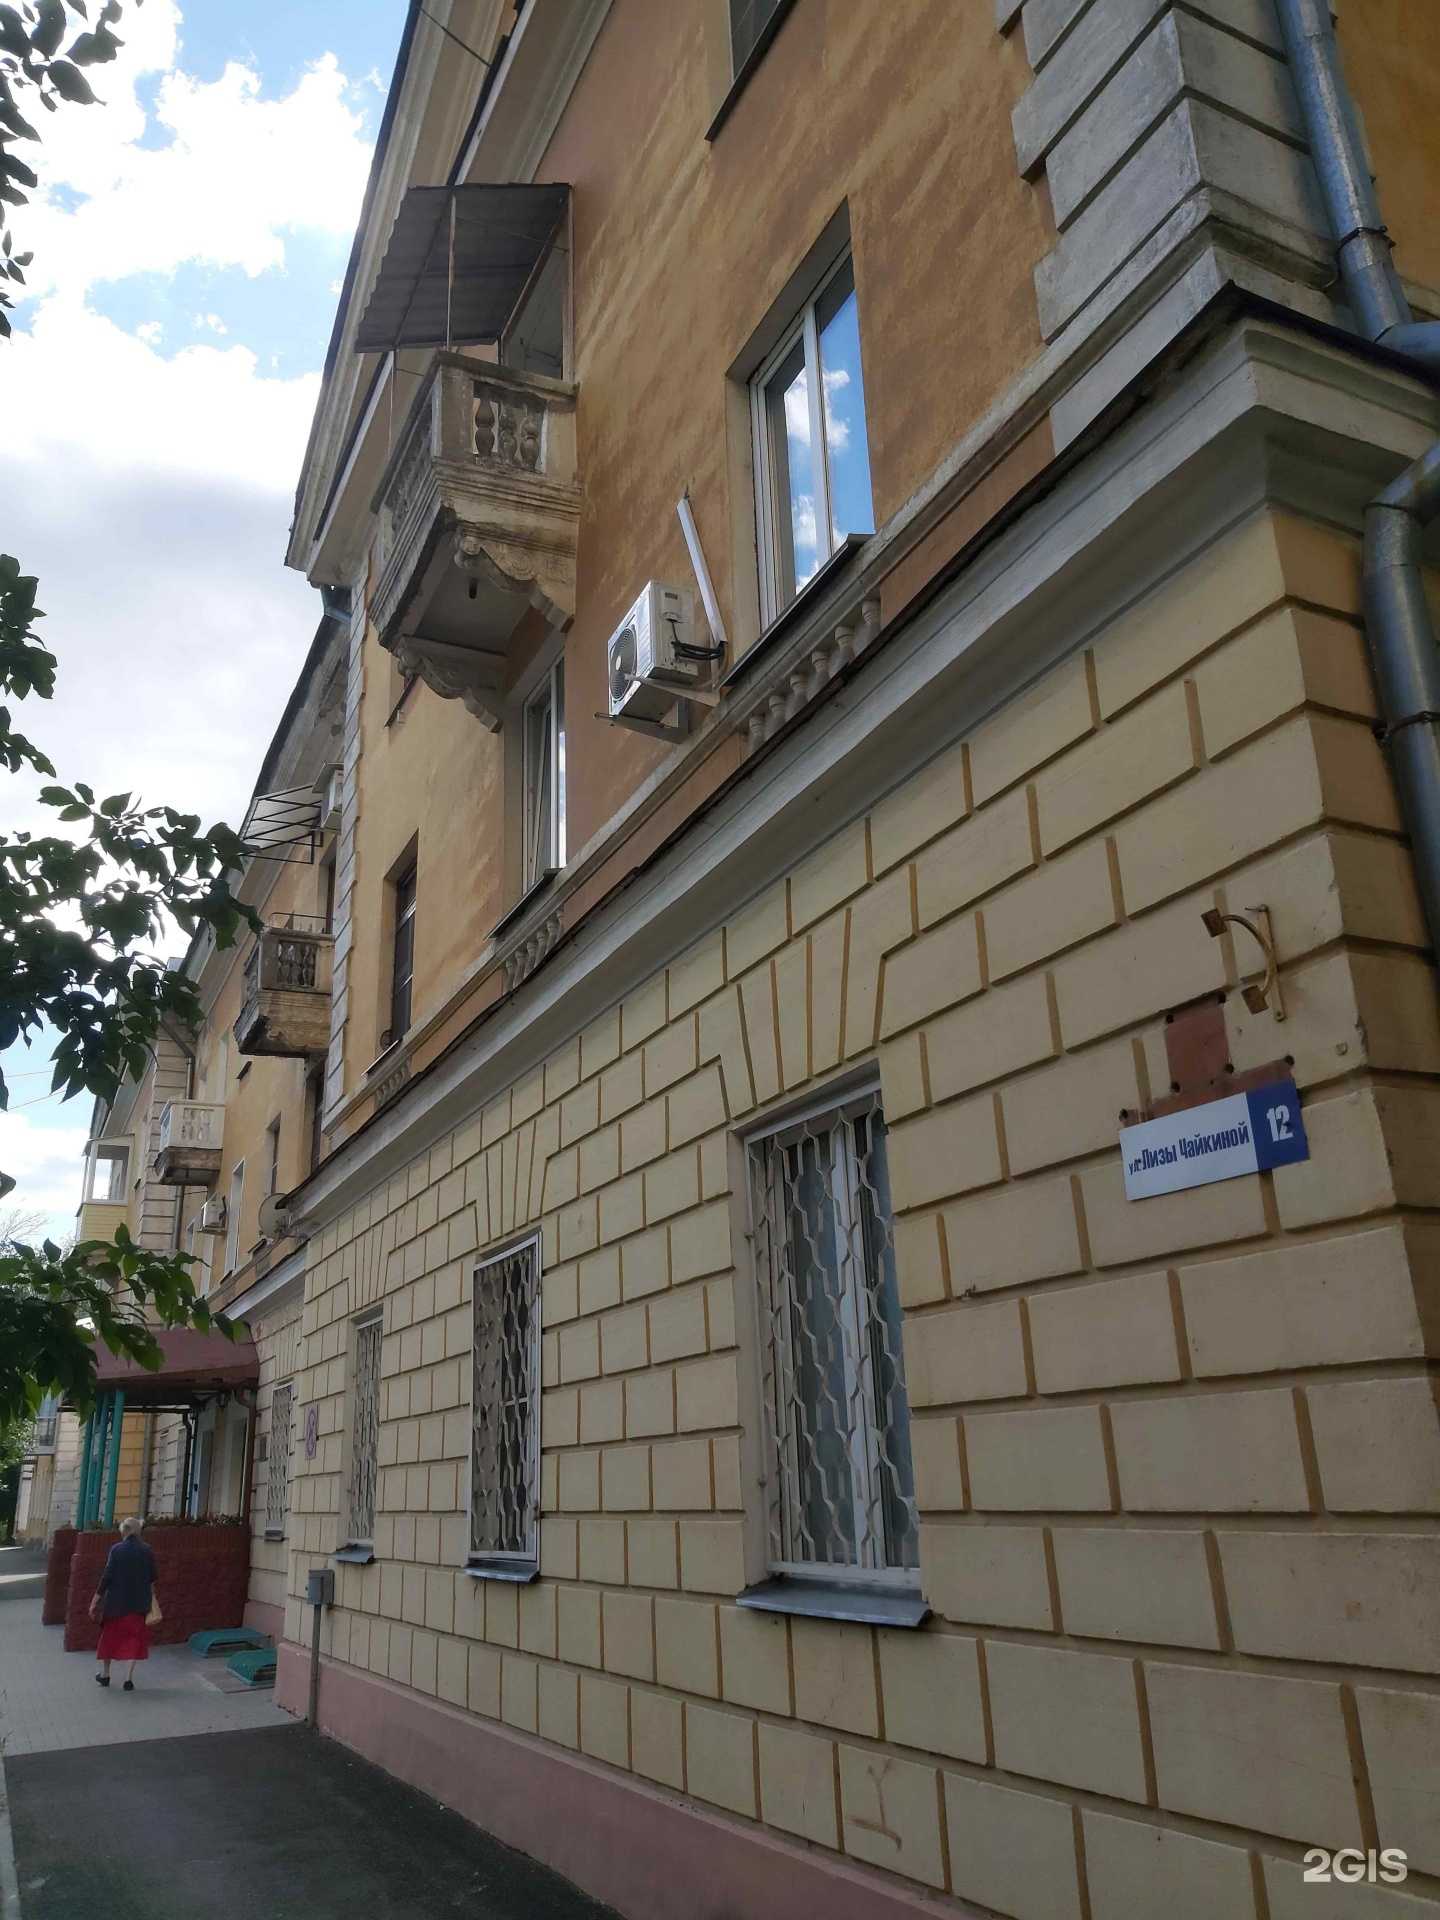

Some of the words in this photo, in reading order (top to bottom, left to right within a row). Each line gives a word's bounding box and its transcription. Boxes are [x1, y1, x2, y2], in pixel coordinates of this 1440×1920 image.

[1142, 1144, 1178, 1170] Лизы
[1178, 1121, 1250, 1159] Чайкиной
[1266, 1104, 1294, 1142] 12
